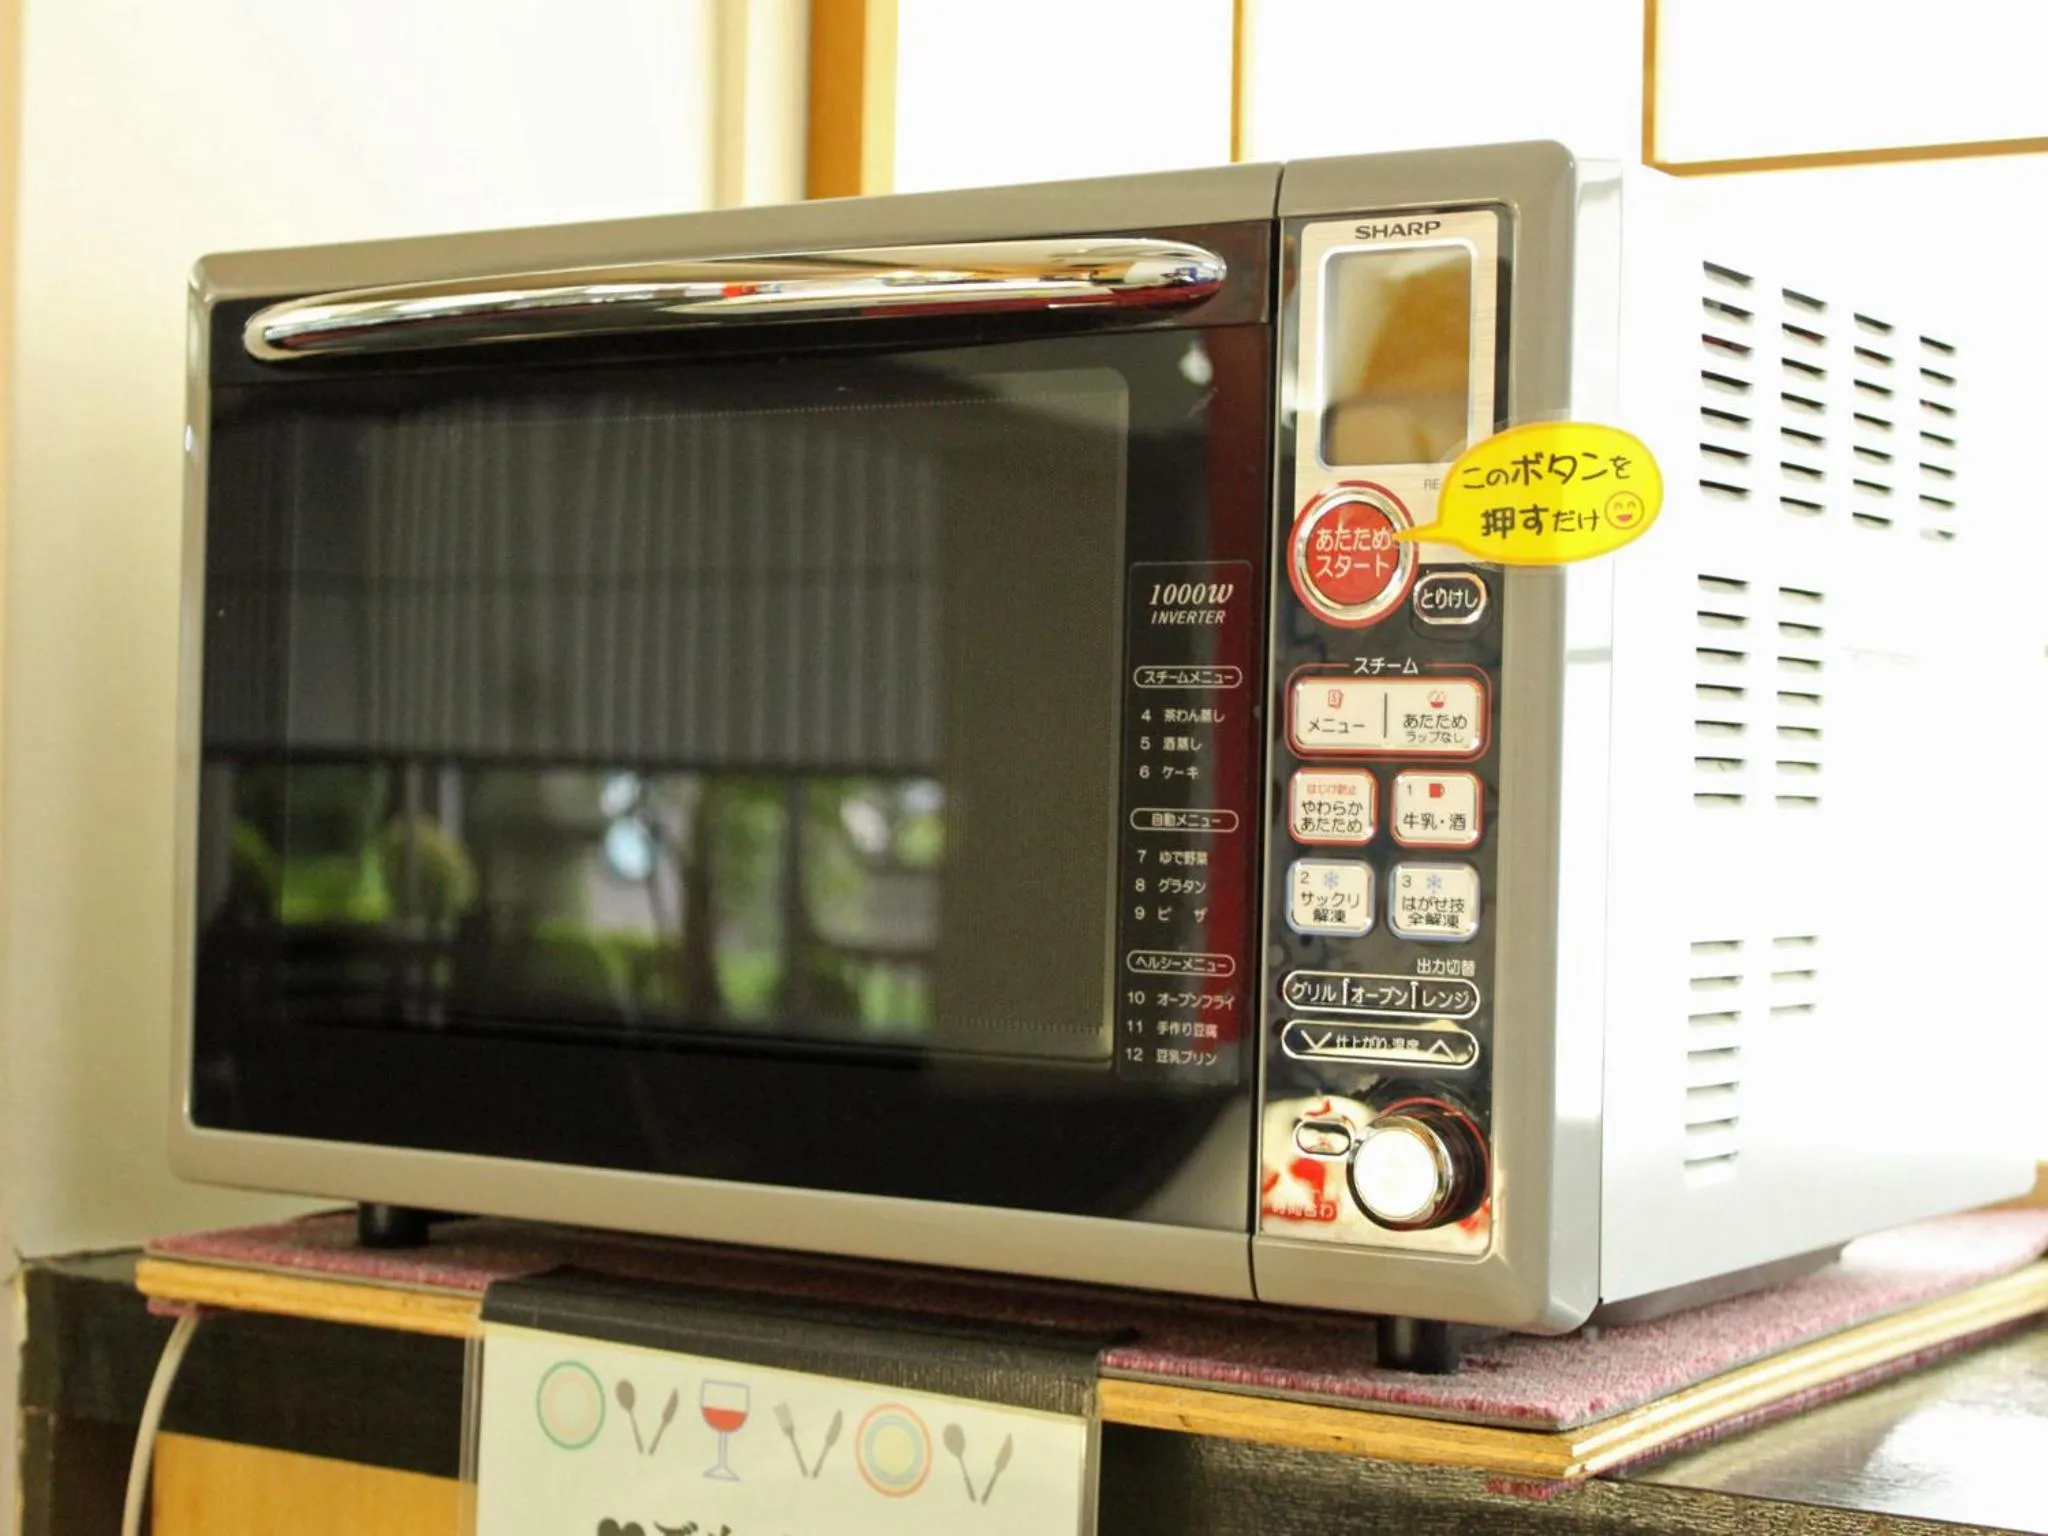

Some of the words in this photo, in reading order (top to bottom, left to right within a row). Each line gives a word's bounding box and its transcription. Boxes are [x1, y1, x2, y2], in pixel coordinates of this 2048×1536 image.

[1355, 220, 1441, 240] SHARP
[1462, 451, 1633, 489] このボタンを
[1480, 503, 1600, 540] 押すだけ
[1315, 526, 1393, 551] あたため
[1315, 555, 1390, 578] スタート
[1149, 583, 1234, 606] 1000W
[1420, 587, 1478, 609] とりけし
[1150, 609, 1226, 625] INVERTER
[1353, 657, 1419, 675] スチーム
[1144, 670, 1234, 684] スチームメニュー
[1141, 709, 1151, 722] 4
[1403, 713, 1468, 730] あたため
[1307, 718, 1365, 734] メニュー
[1140, 737, 1150, 750] 5
[1406, 730, 1464, 743] ラップなし
[1139, 766, 1150, 779] 6
[1162, 766, 1199, 779] ケーキ
[1407, 785, 1412, 796] 1
[1301, 800, 1363, 816] やわらか
[1151, 813, 1221, 828] 自動メニュー
[1300, 816, 1363, 833] あたため
[1403, 812, 1467, 832] 牛乳・酒
[1137, 850, 1147, 863] 7
[1159, 851, 1208, 866] ゆで野菜
[1300, 871, 1309, 884] 2
[1401, 875, 1412, 888] 3
[1135, 879, 1146, 892] 8
[1158, 879, 1206, 894] グラタン
[1300, 891, 1360, 907] サックリ
[1401, 896, 1465, 913] はがせ技
[1134, 907, 1145, 920] 9
[1312, 908, 1347, 924] 解凍
[1407, 912, 1460, 929] 全解凍
[1135, 955, 1227, 972] ヘルシーメニュー
[1417, 957, 1475, 977] 出力切替
[1127, 991, 1146, 1004] 10
[1156, 992, 1234, 1010] オープンフライ
[1291, 982, 1336, 1001] グリル
[1350, 986, 1410, 1007] オープン
[1421, 989, 1470, 1008] レンジ
[1126, 1020, 1143, 1033] 11
[1156, 1021, 1218, 1039] 手作り豆腐
[1125, 1048, 1143, 1061] 12
